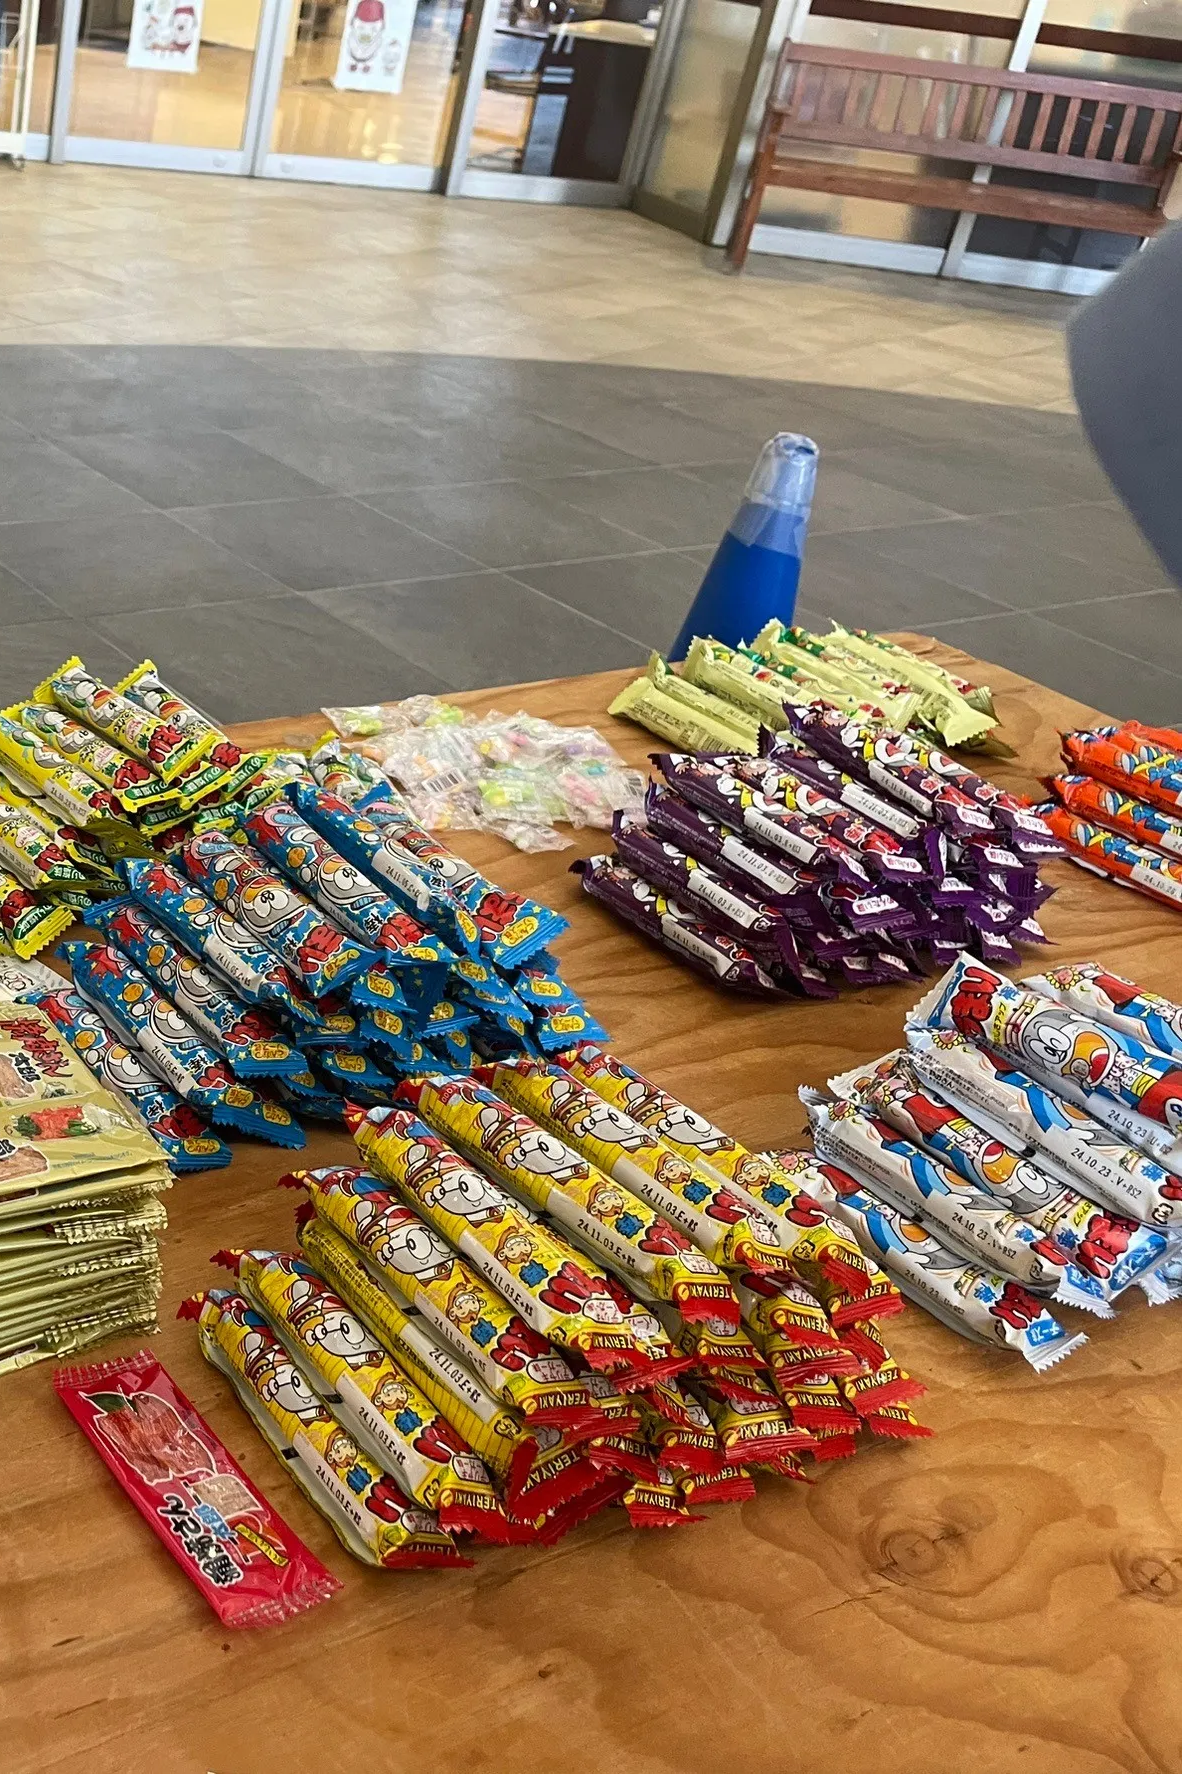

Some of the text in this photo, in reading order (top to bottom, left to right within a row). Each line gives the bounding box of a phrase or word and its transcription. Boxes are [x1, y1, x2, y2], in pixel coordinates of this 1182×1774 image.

[9, 1051, 41, 1083] 太郎
[539, 1392, 586, 1410] TERIYAKI
[798, 1393, 841, 1408] TERIYAKI
[739, 1421, 794, 1440] TERIYAKI
[605, 1436, 647, 1457] TERIYAKI
[455, 1491, 497, 1510] TERIYAKI
[636, 1491, 676, 1509] TERIYAKI
